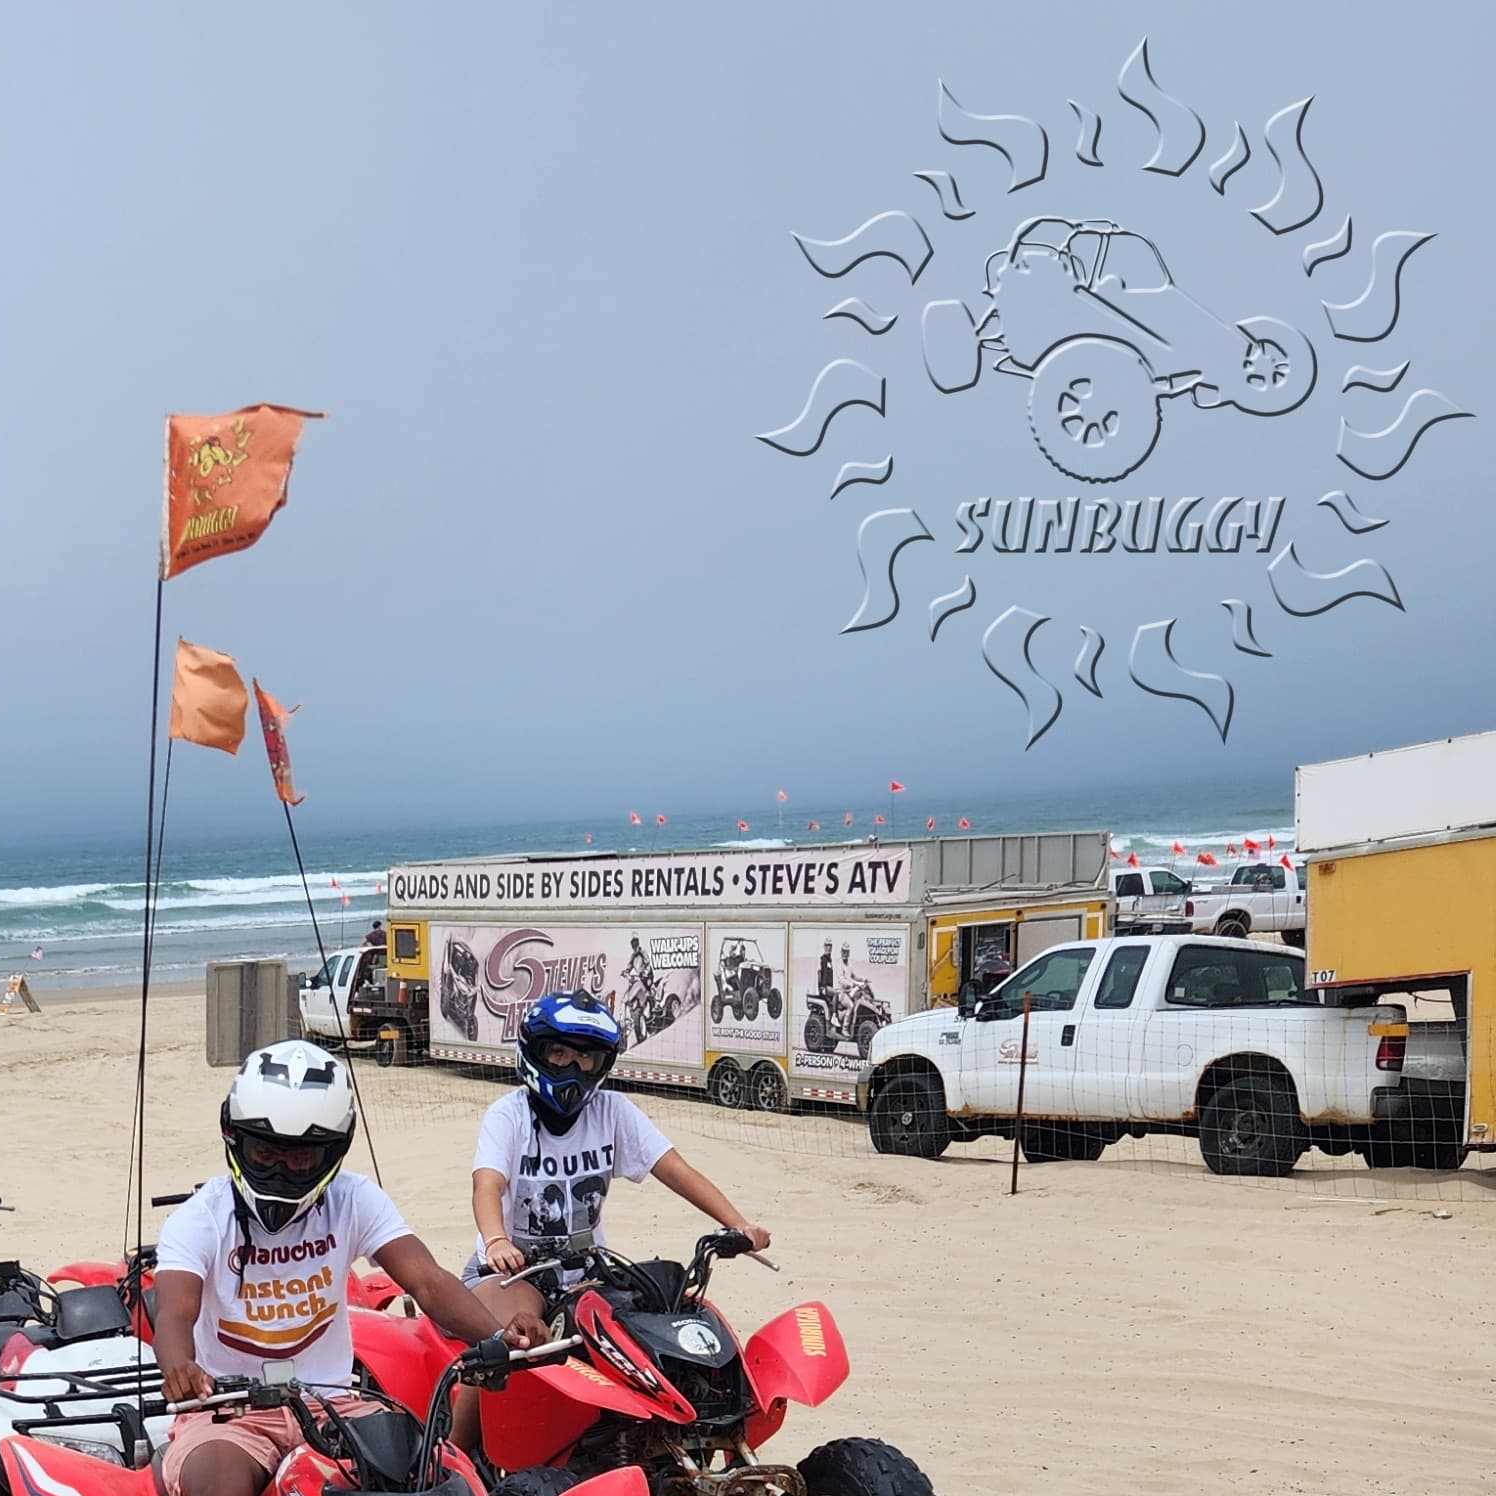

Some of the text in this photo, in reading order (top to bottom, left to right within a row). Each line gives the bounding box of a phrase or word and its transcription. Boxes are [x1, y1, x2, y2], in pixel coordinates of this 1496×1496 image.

[394, 860, 904, 902] QUADS AND SIDE BY SIDES RENTALS STEVE'S ATV
[650, 936, 699, 953] WALK-UPS
[652, 951, 699, 969] WELCOME
[519, 1144, 614, 1177] MOUNT
[238, 1265, 333, 1299] nstant
[245, 1293, 327, 1322] Lunch
